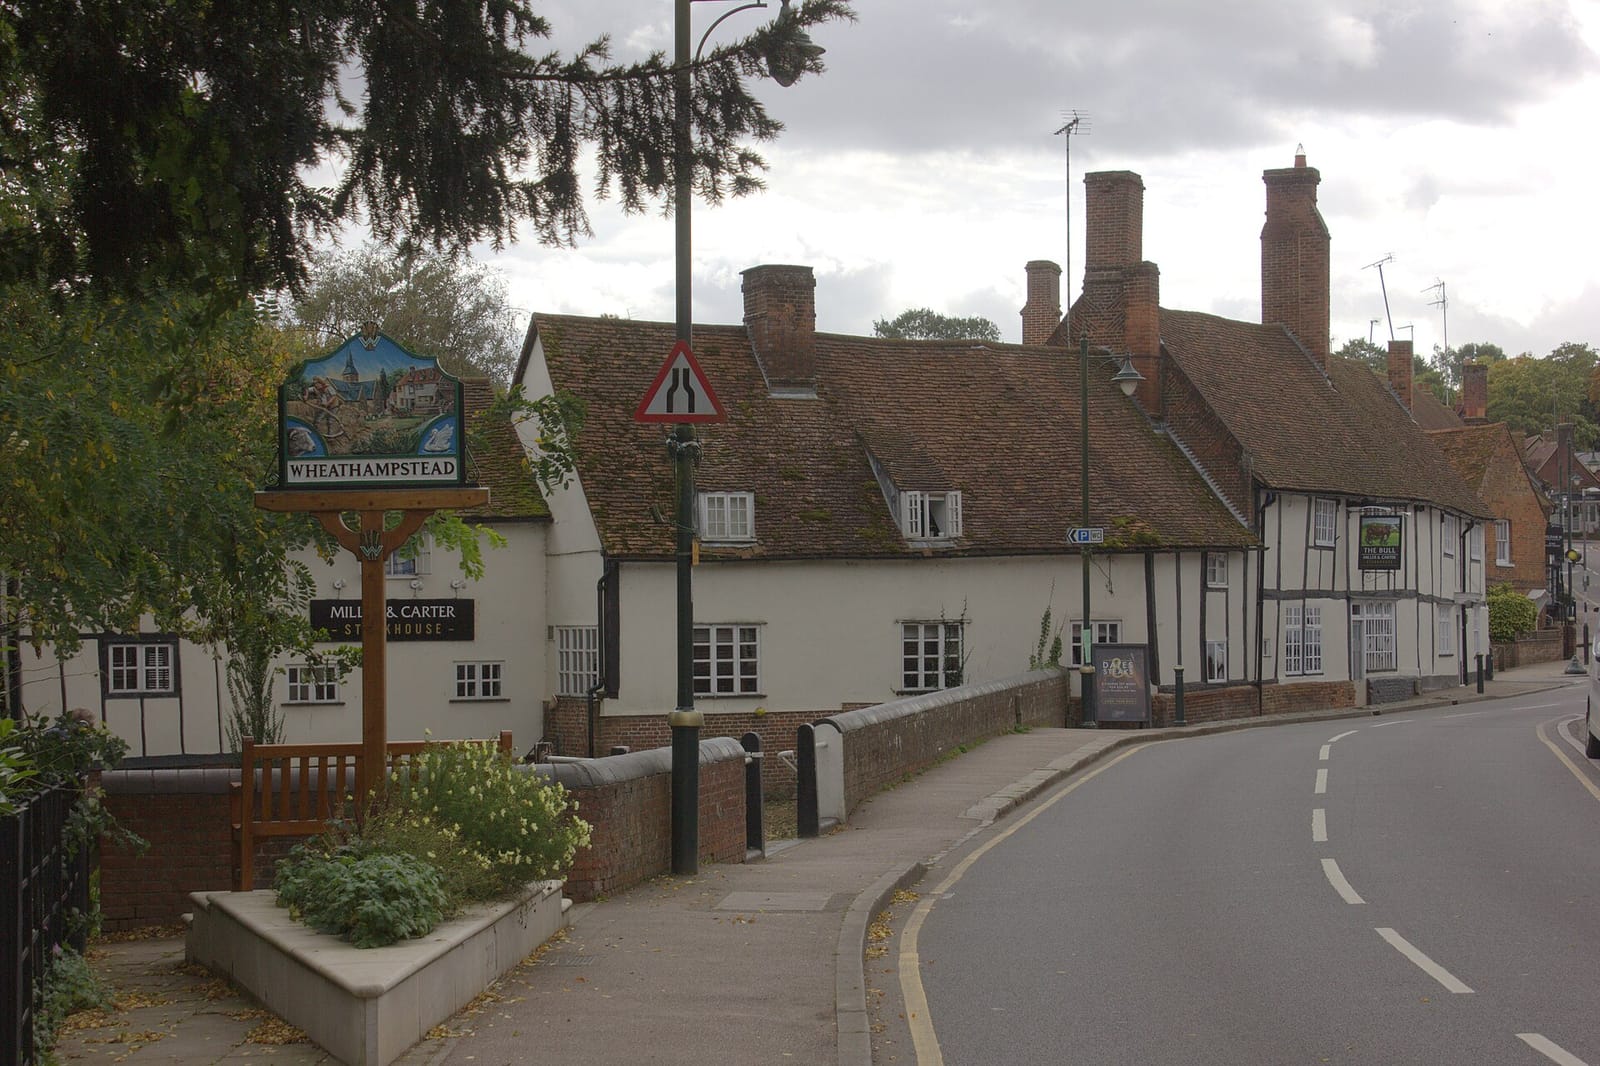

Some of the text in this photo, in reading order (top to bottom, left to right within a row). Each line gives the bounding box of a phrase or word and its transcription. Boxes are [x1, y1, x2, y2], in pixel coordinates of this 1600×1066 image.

[290, 461, 455, 478] WHEATHAMPSTEAD
[1080, 531, 1088, 540] P
[330, 605, 456, 619] MILL & CARTER
[344, 623, 442, 635] STKHOUSE
[1102, 661, 1134, 669] DAES
